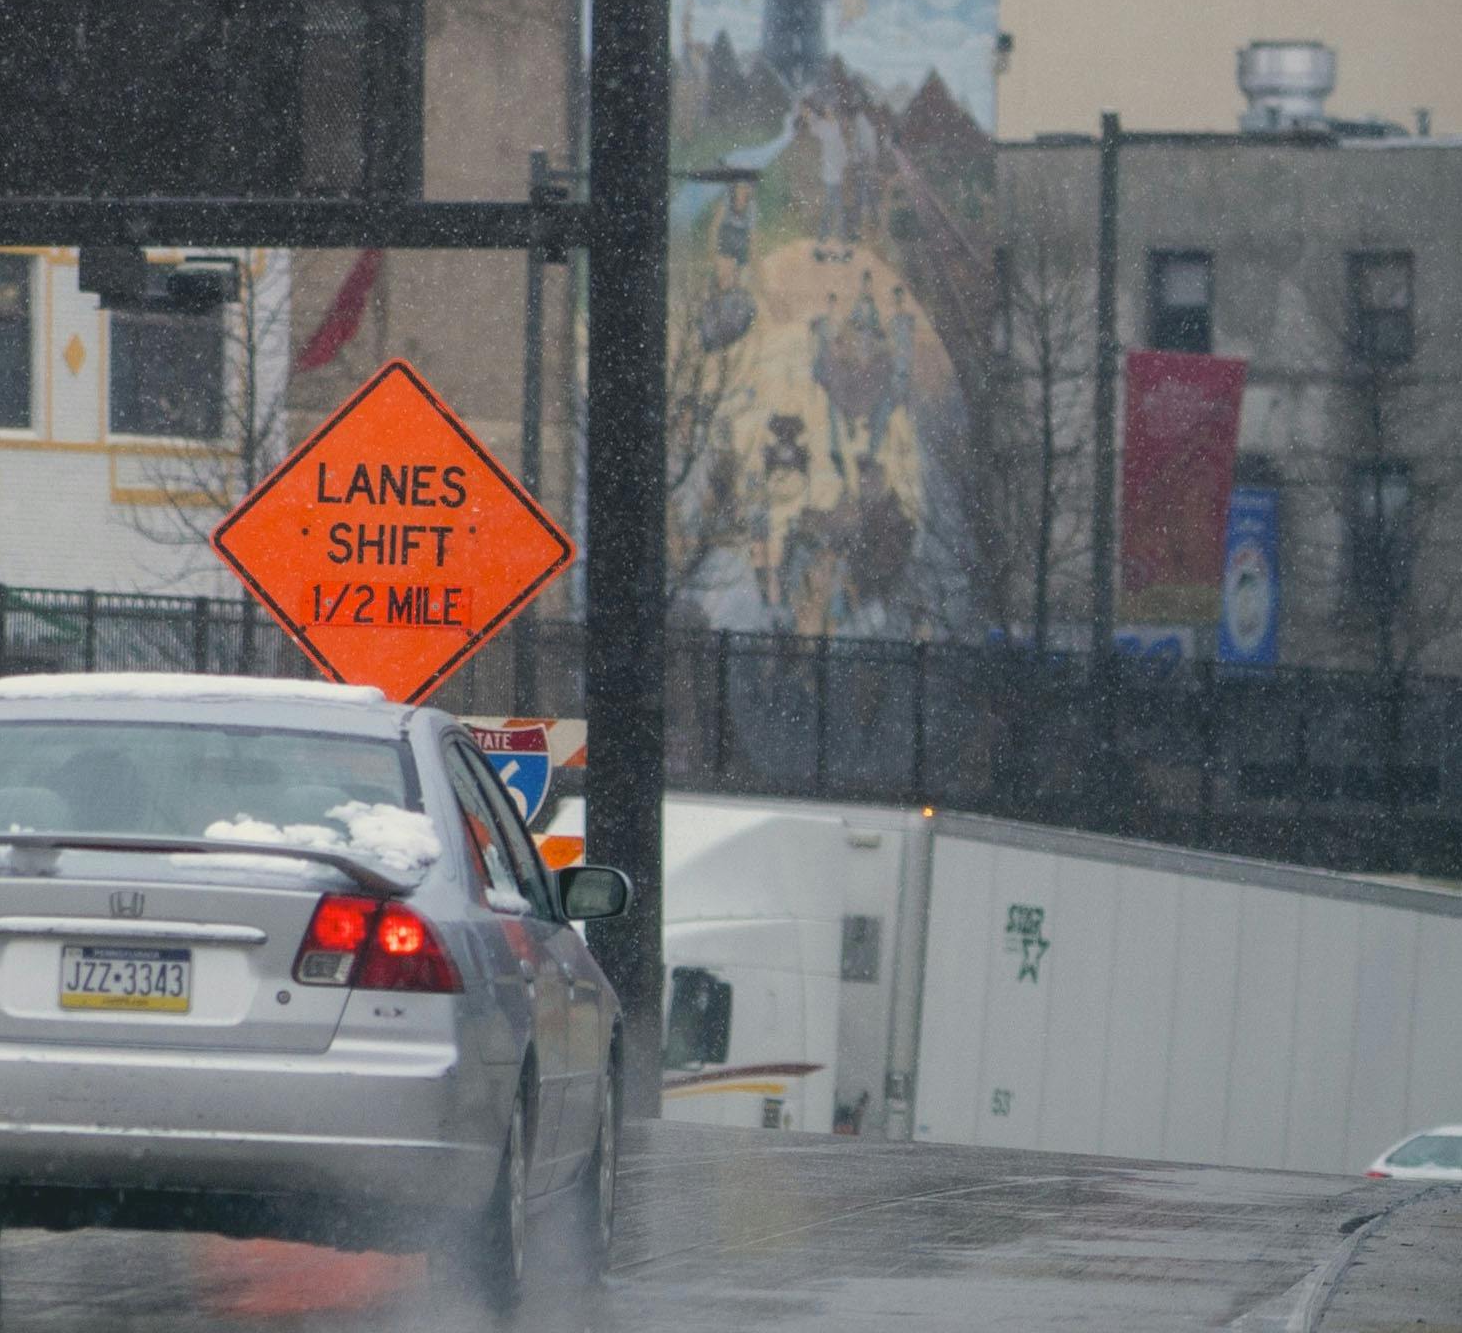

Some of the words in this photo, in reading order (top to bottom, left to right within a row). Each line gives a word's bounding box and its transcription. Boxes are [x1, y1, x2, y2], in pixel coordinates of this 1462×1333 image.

[318, 462, 467, 508] LANES
[328, 522, 454, 567] SHIFT
[313, 584, 375, 624] 1/2
[387, 586, 463, 626] MILE
